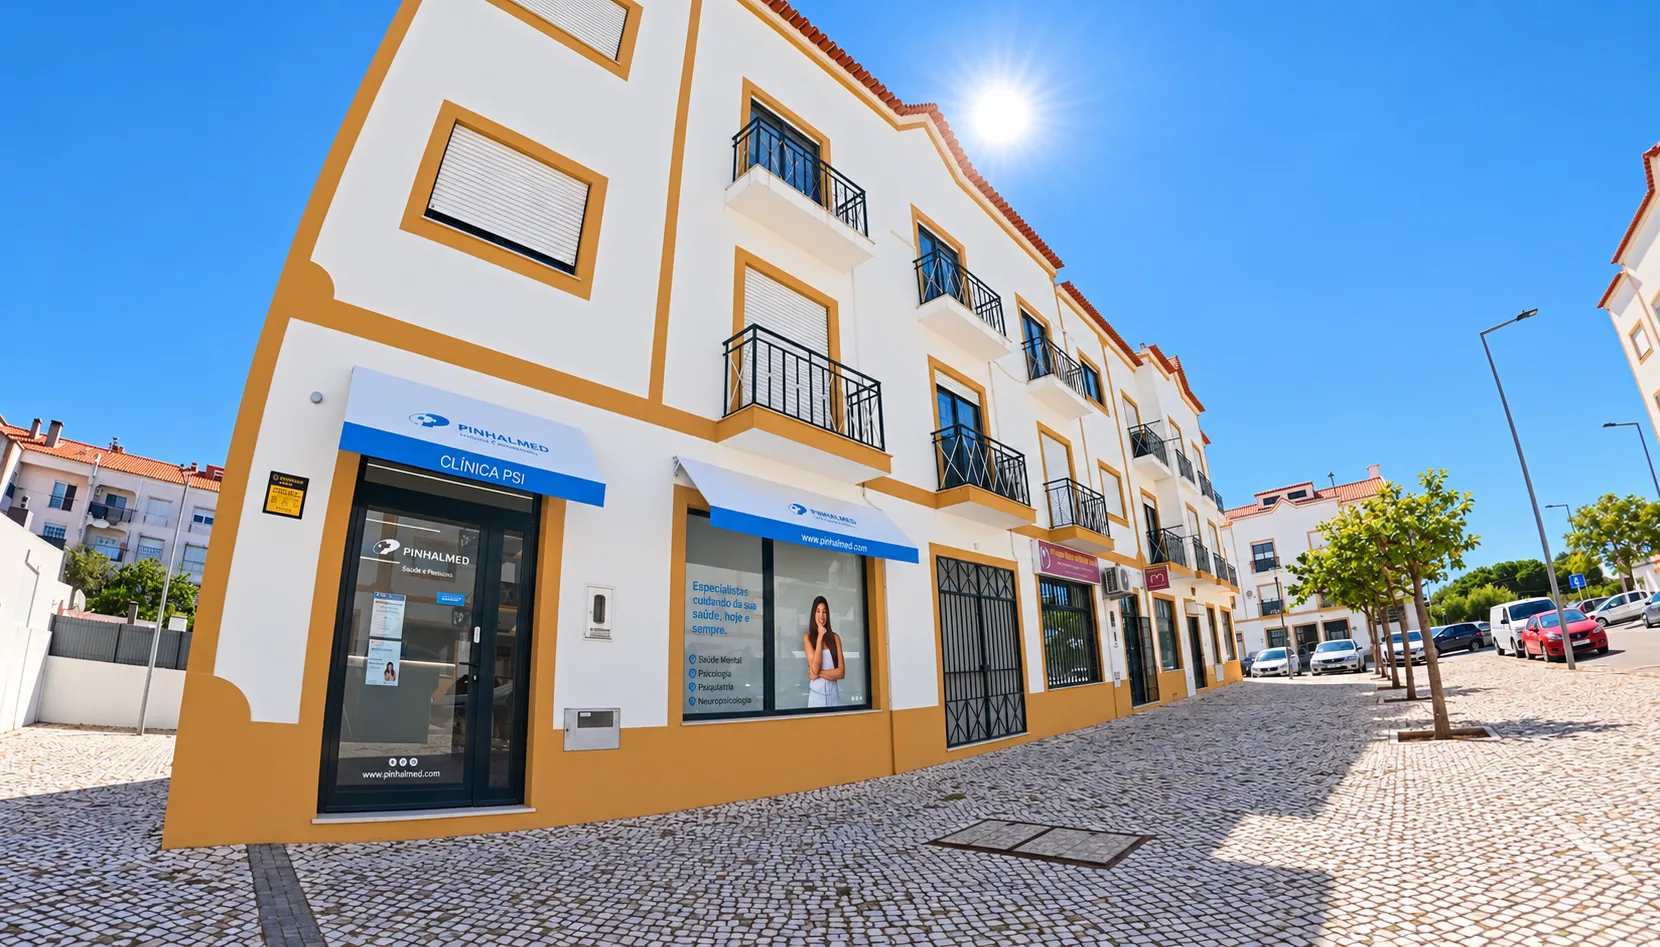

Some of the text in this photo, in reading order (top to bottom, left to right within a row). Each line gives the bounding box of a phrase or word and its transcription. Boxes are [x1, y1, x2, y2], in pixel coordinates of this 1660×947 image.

[458, 423, 550, 453] PINHALMED
[440, 455, 525, 485] CLÍNICA PSI
[403, 547, 470, 565] PINHALMED
[692, 581, 749, 597] Especialistas
[692, 596, 757, 610] cuidando da sua
[692, 608, 722, 622] saúde,
[724, 611, 743, 624] hoje
[691, 624, 728, 637] sempre.
[698, 655, 719, 664] Saúde
[698, 669, 732, 679] Psicologia
[698, 683, 734, 692] Psiquiatria
[697, 696, 752, 706] Neuropsicologia
[362, 769, 440, 780] www.pinhalmed.com
